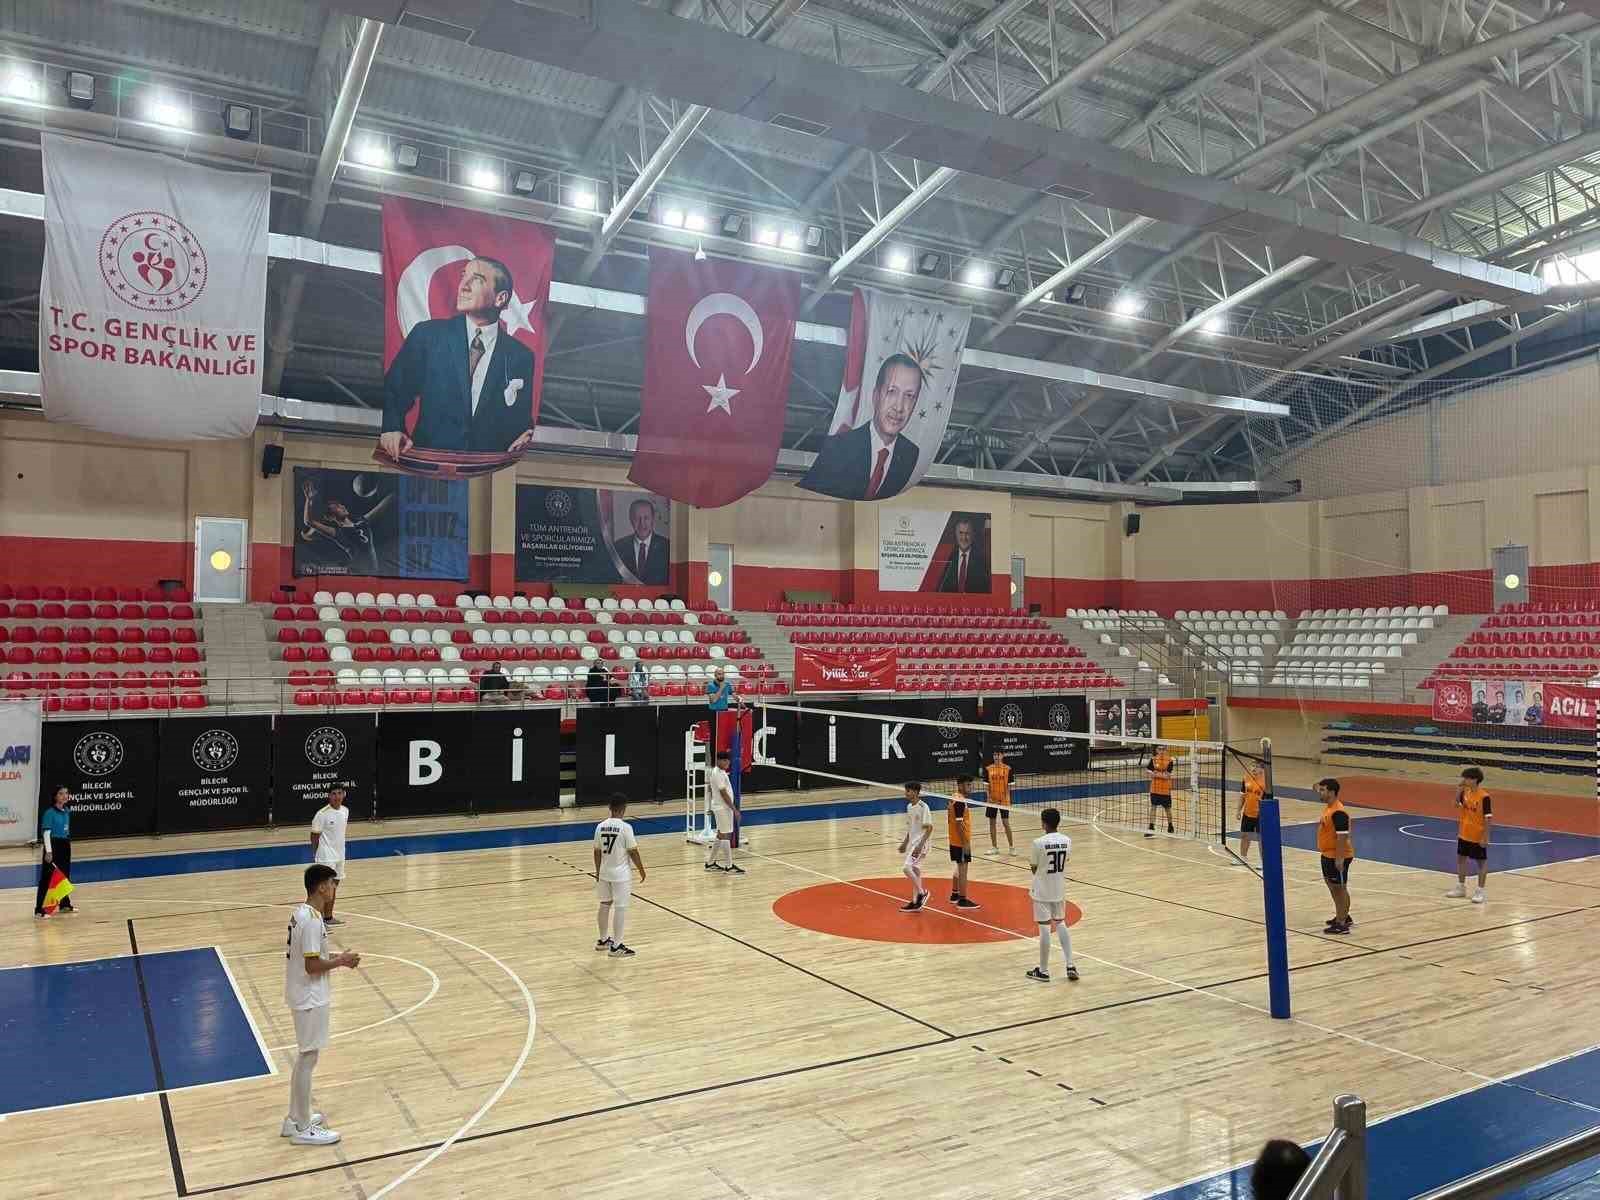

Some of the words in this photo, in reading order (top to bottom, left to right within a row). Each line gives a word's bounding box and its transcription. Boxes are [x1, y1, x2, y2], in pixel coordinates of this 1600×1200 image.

[50, 306, 95, 332] T.C.
[104, 318, 217, 350] GENÇLİK
[226, 334, 256, 351] VE
[49, 334, 116, 361] SPOR
[124, 347, 255, 375] BAKANLIĞI
[82, 781, 112, 790] BİLECİK
[601, 834, 618, 854] 37
[1047, 850, 1067, 873] 30
